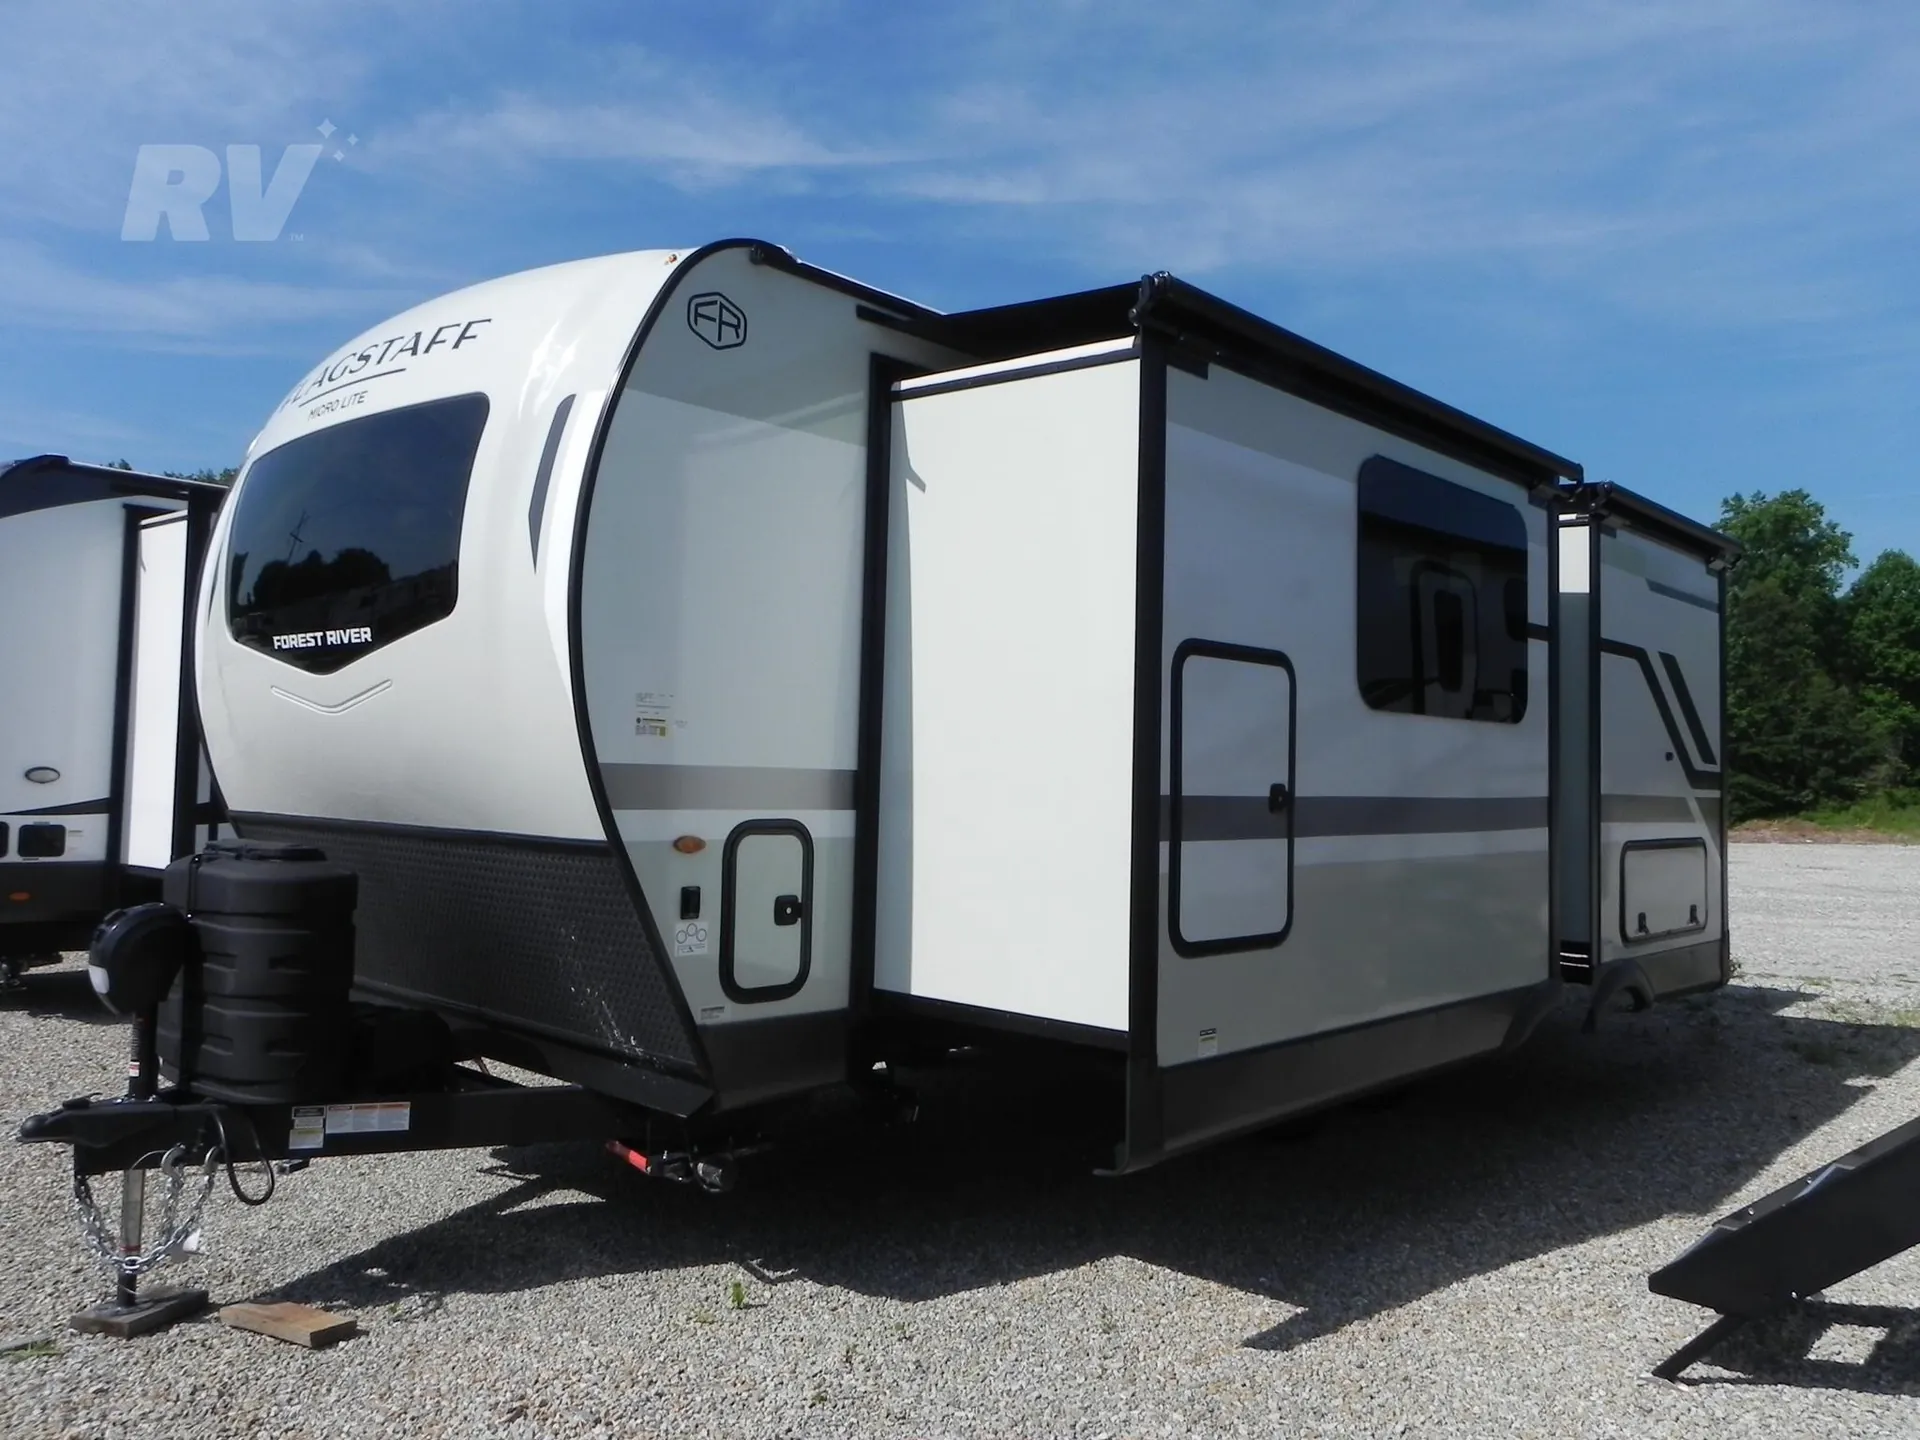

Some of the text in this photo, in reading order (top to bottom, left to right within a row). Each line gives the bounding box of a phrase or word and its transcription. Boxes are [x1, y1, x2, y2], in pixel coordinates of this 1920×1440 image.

[308, 390, 368, 421] MICRO LITE
[272, 626, 373, 650] FOREST RIVER
